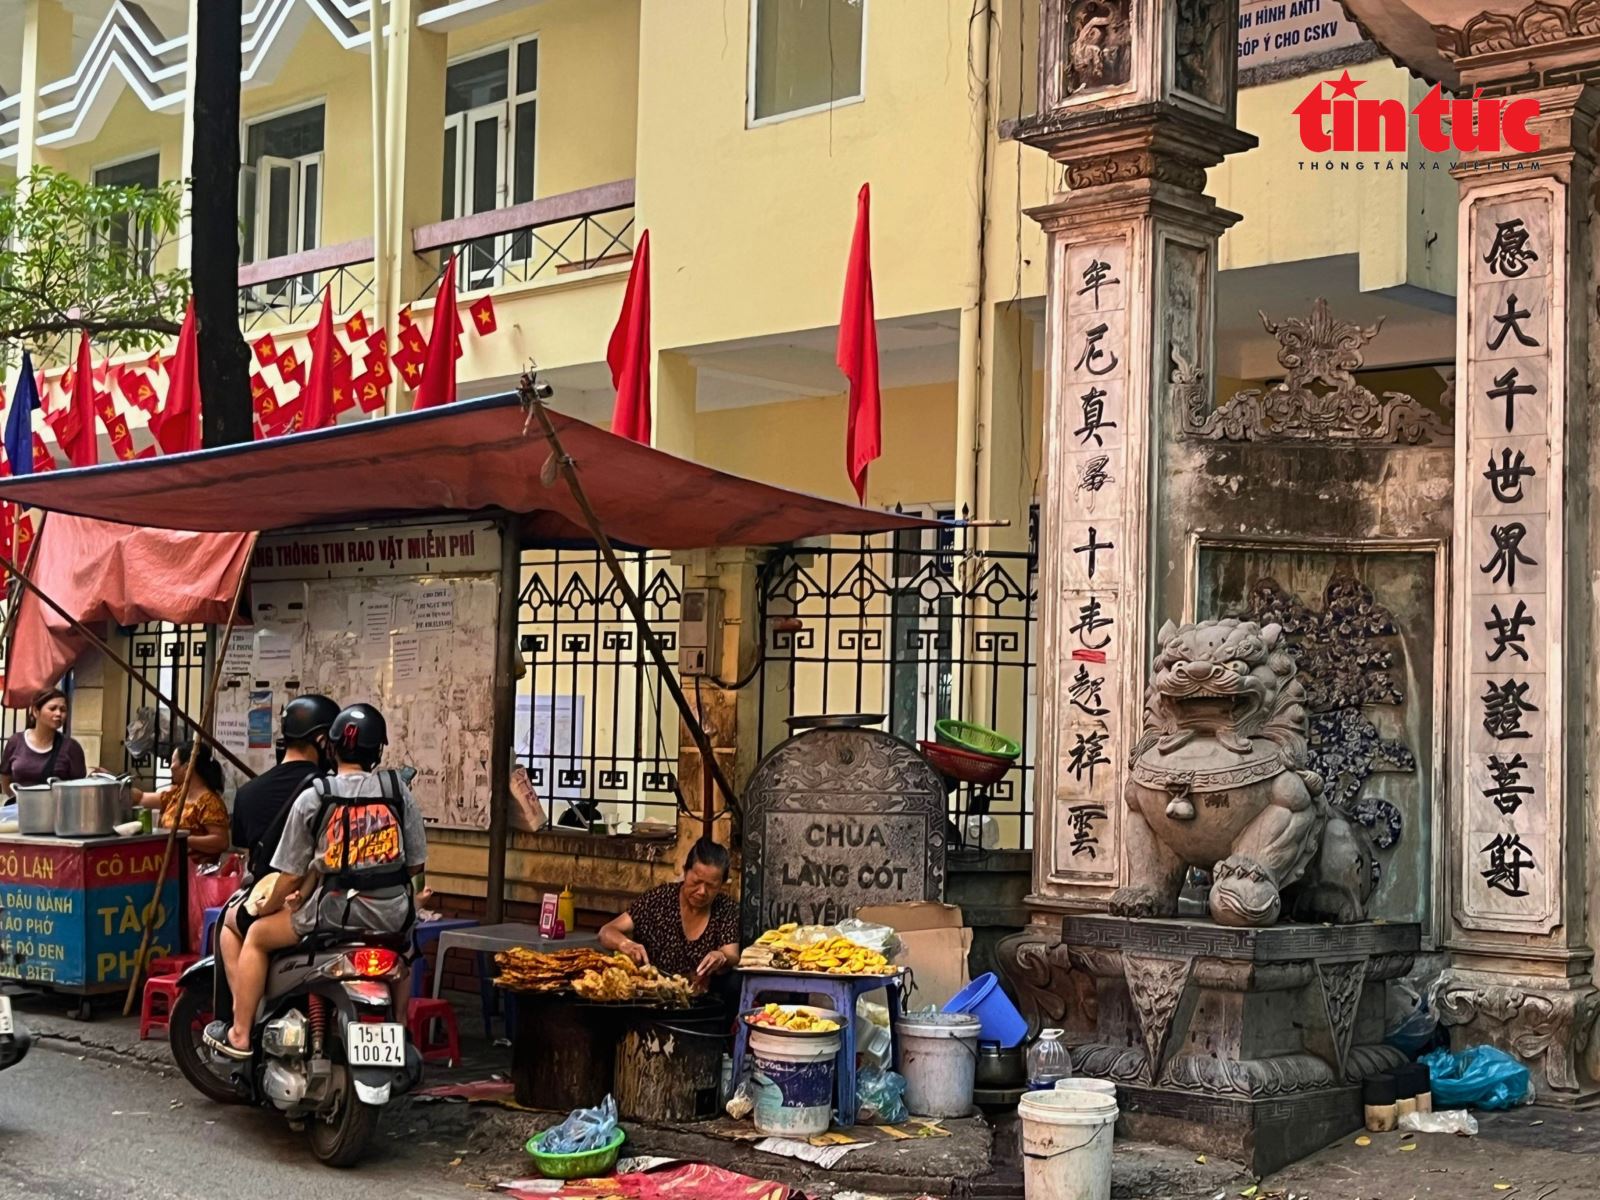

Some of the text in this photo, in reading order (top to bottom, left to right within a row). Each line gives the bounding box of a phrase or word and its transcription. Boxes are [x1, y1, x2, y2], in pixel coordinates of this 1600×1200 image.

[1255, 4, 1286, 26] HÌNH
[1238, 20, 1338, 57] GÓP Ý CHO CSKV
[276, 542, 320, 567] THÔNG
[322, 542, 345, 564] TIN
[347, 540, 375, 562] RAO
[449, 529, 475, 557] PHÍ
[805, 817, 886, 848] CHÙA
[23, 856, 53, 880] LAN
[96, 853, 166, 877] CÔ LAN
[782, 855, 850, 888] LÀNG
[0, 911, 22, 932] ÀO
[97, 896, 166, 936] TÀO
[38, 943, 64, 961] ĐEN
[353, 1045, 401, 1063] 100.24
